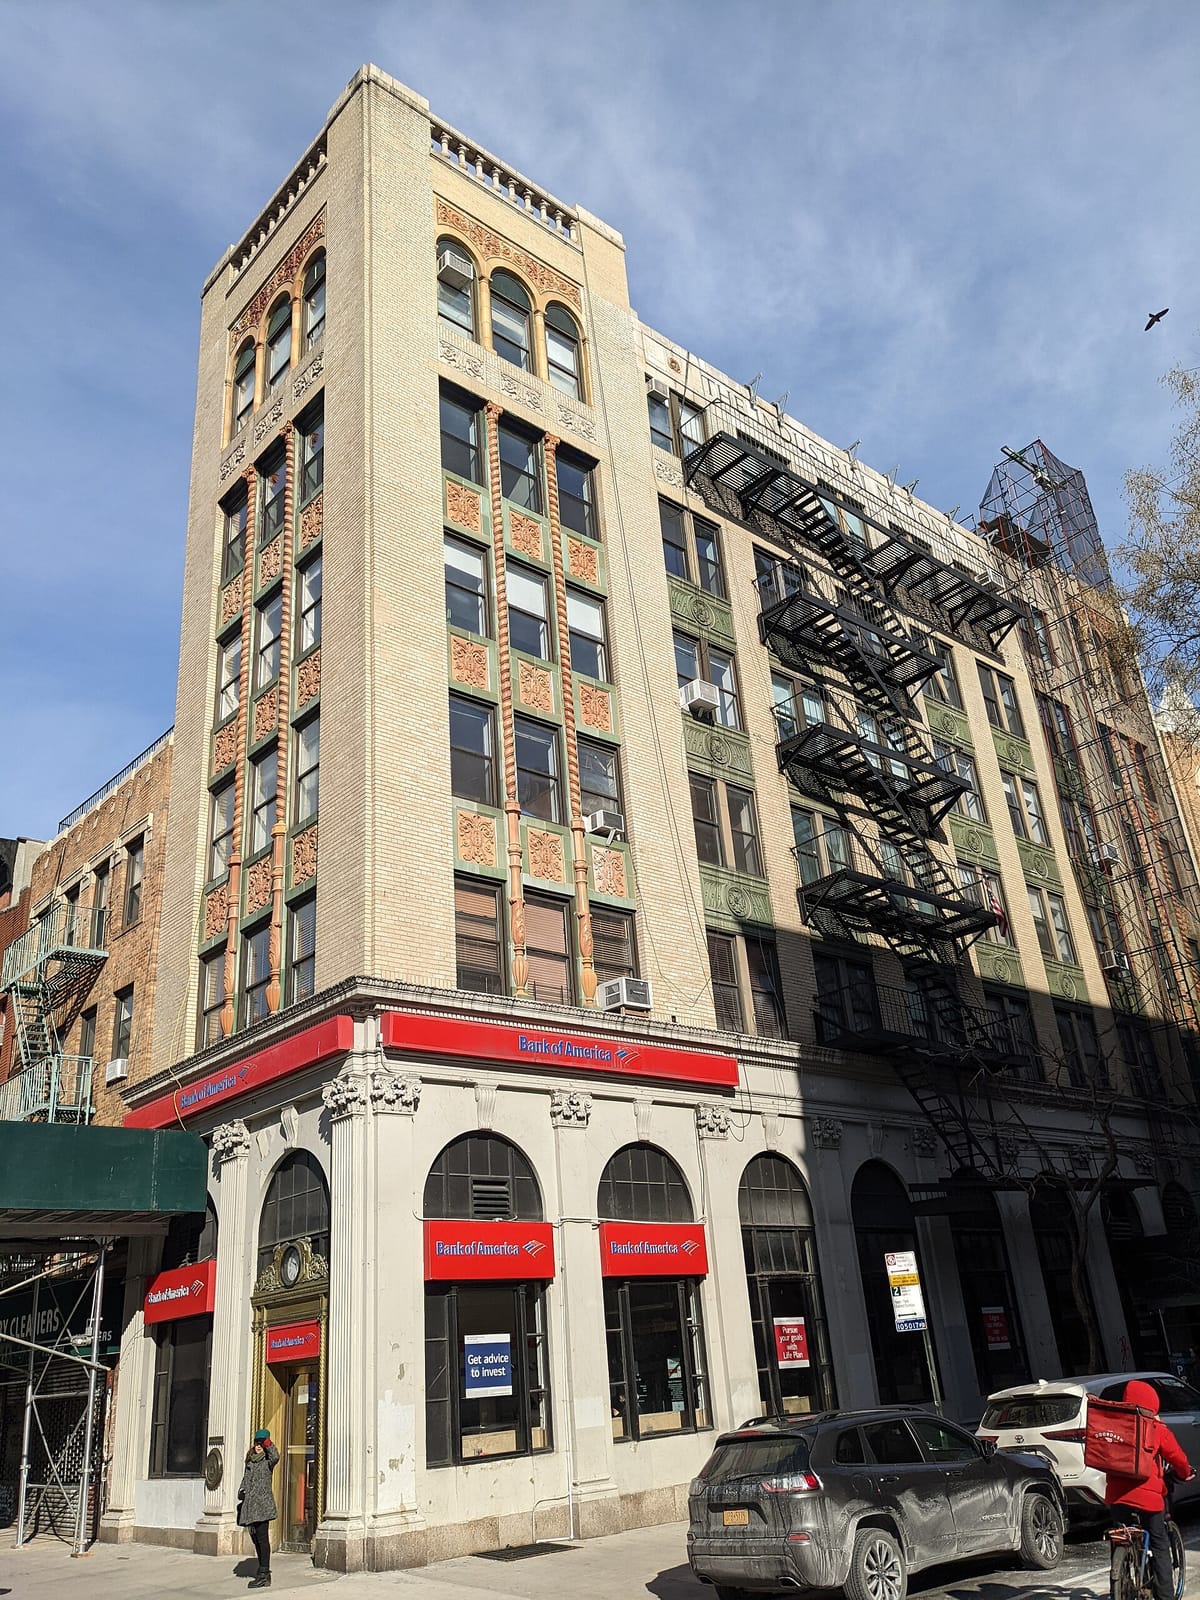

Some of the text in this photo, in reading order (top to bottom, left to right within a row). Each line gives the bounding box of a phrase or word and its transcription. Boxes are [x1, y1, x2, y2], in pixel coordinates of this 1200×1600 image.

[700, 373, 746, 411] THE
[518, 1035, 612, 1061] Bank of America
[181, 1075, 236, 1108] Bank of America
[435, 1240, 519, 1256] Bank of America
[610, 1240, 678, 1254] Bank of America
[894, 1287, 899, 1295] 2
[782, 1326, 798, 1334] Pursue
[779, 1334, 803, 1343] your goals
[467, 1353, 509, 1365] Get advice
[782, 1351, 804, 1359] Life Plan
[471, 1366, 506, 1377] to invest
